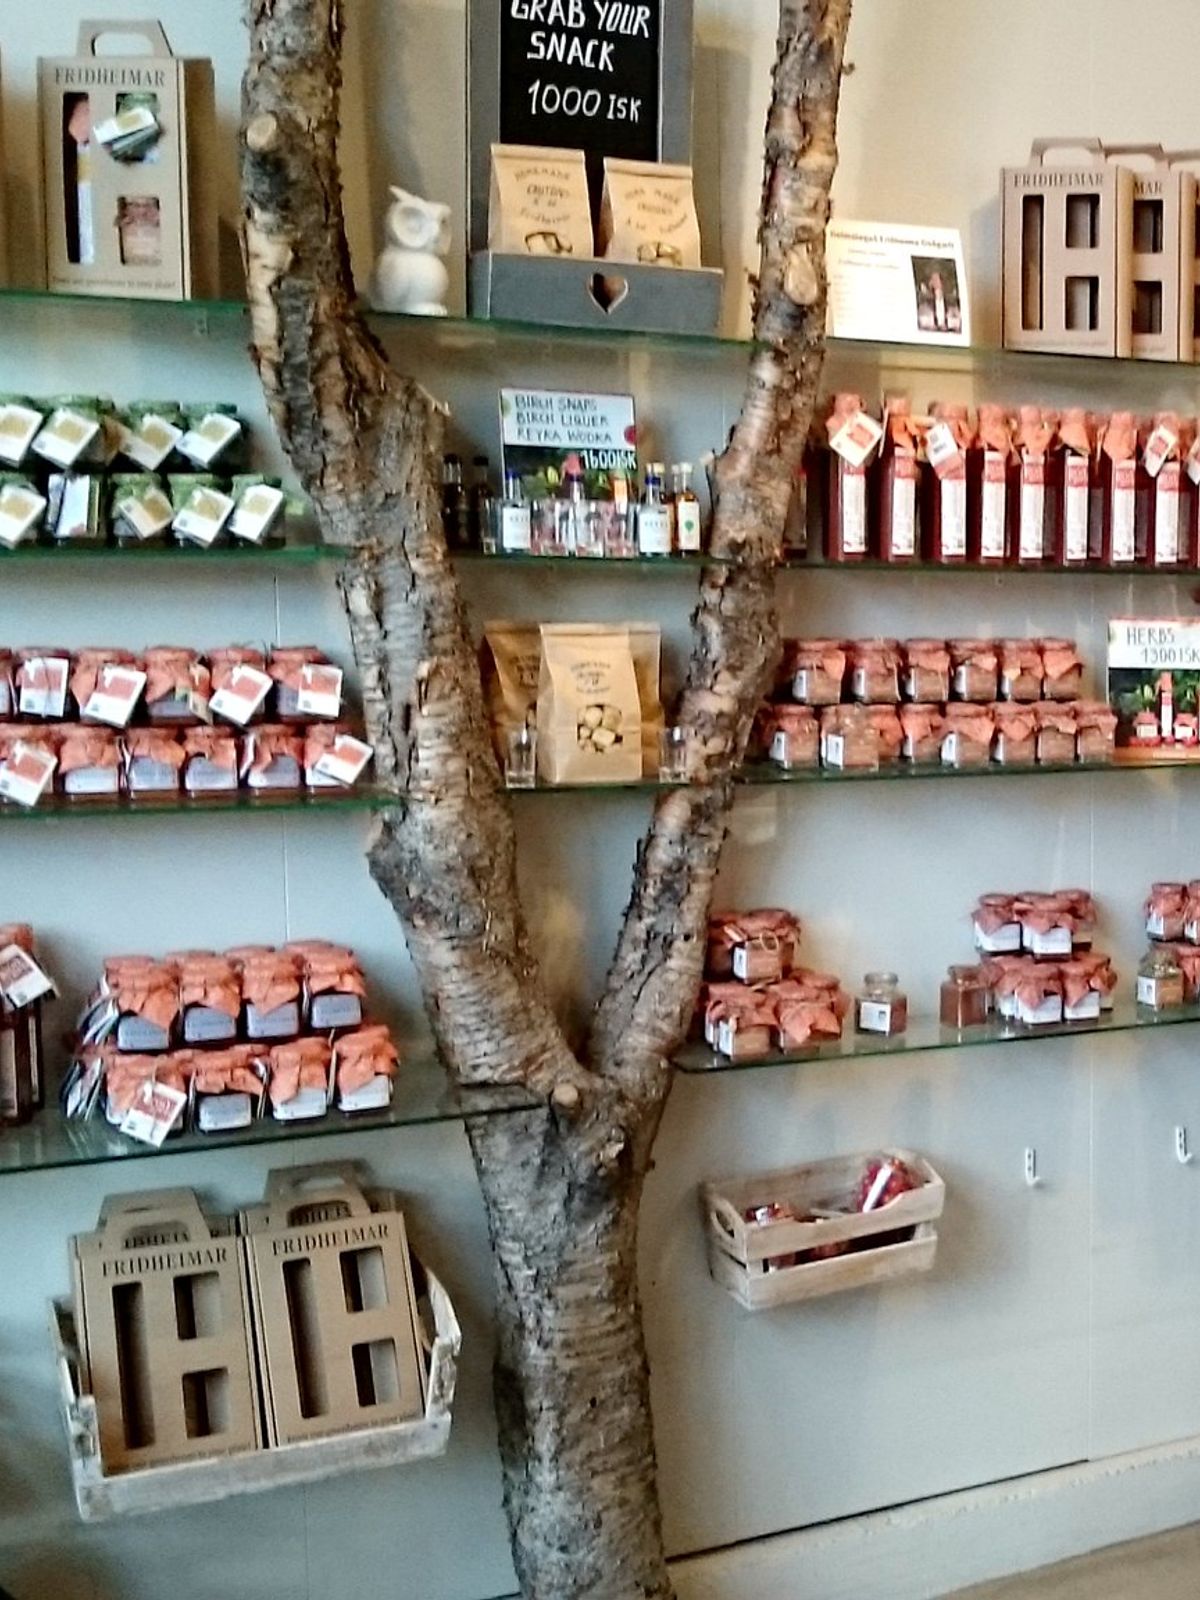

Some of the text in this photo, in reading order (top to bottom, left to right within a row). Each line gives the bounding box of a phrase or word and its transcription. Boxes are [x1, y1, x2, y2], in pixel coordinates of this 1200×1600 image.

[510, 0, 651, 38] GRAB YOUR
[526, 31, 615, 72] SNACK
[528, 78, 642, 123] 1000 ISK
[515, 395, 553, 411] BIRCH
[516, 411, 554, 425] BIRCH
[1127, 626, 1175, 646] HERBS
